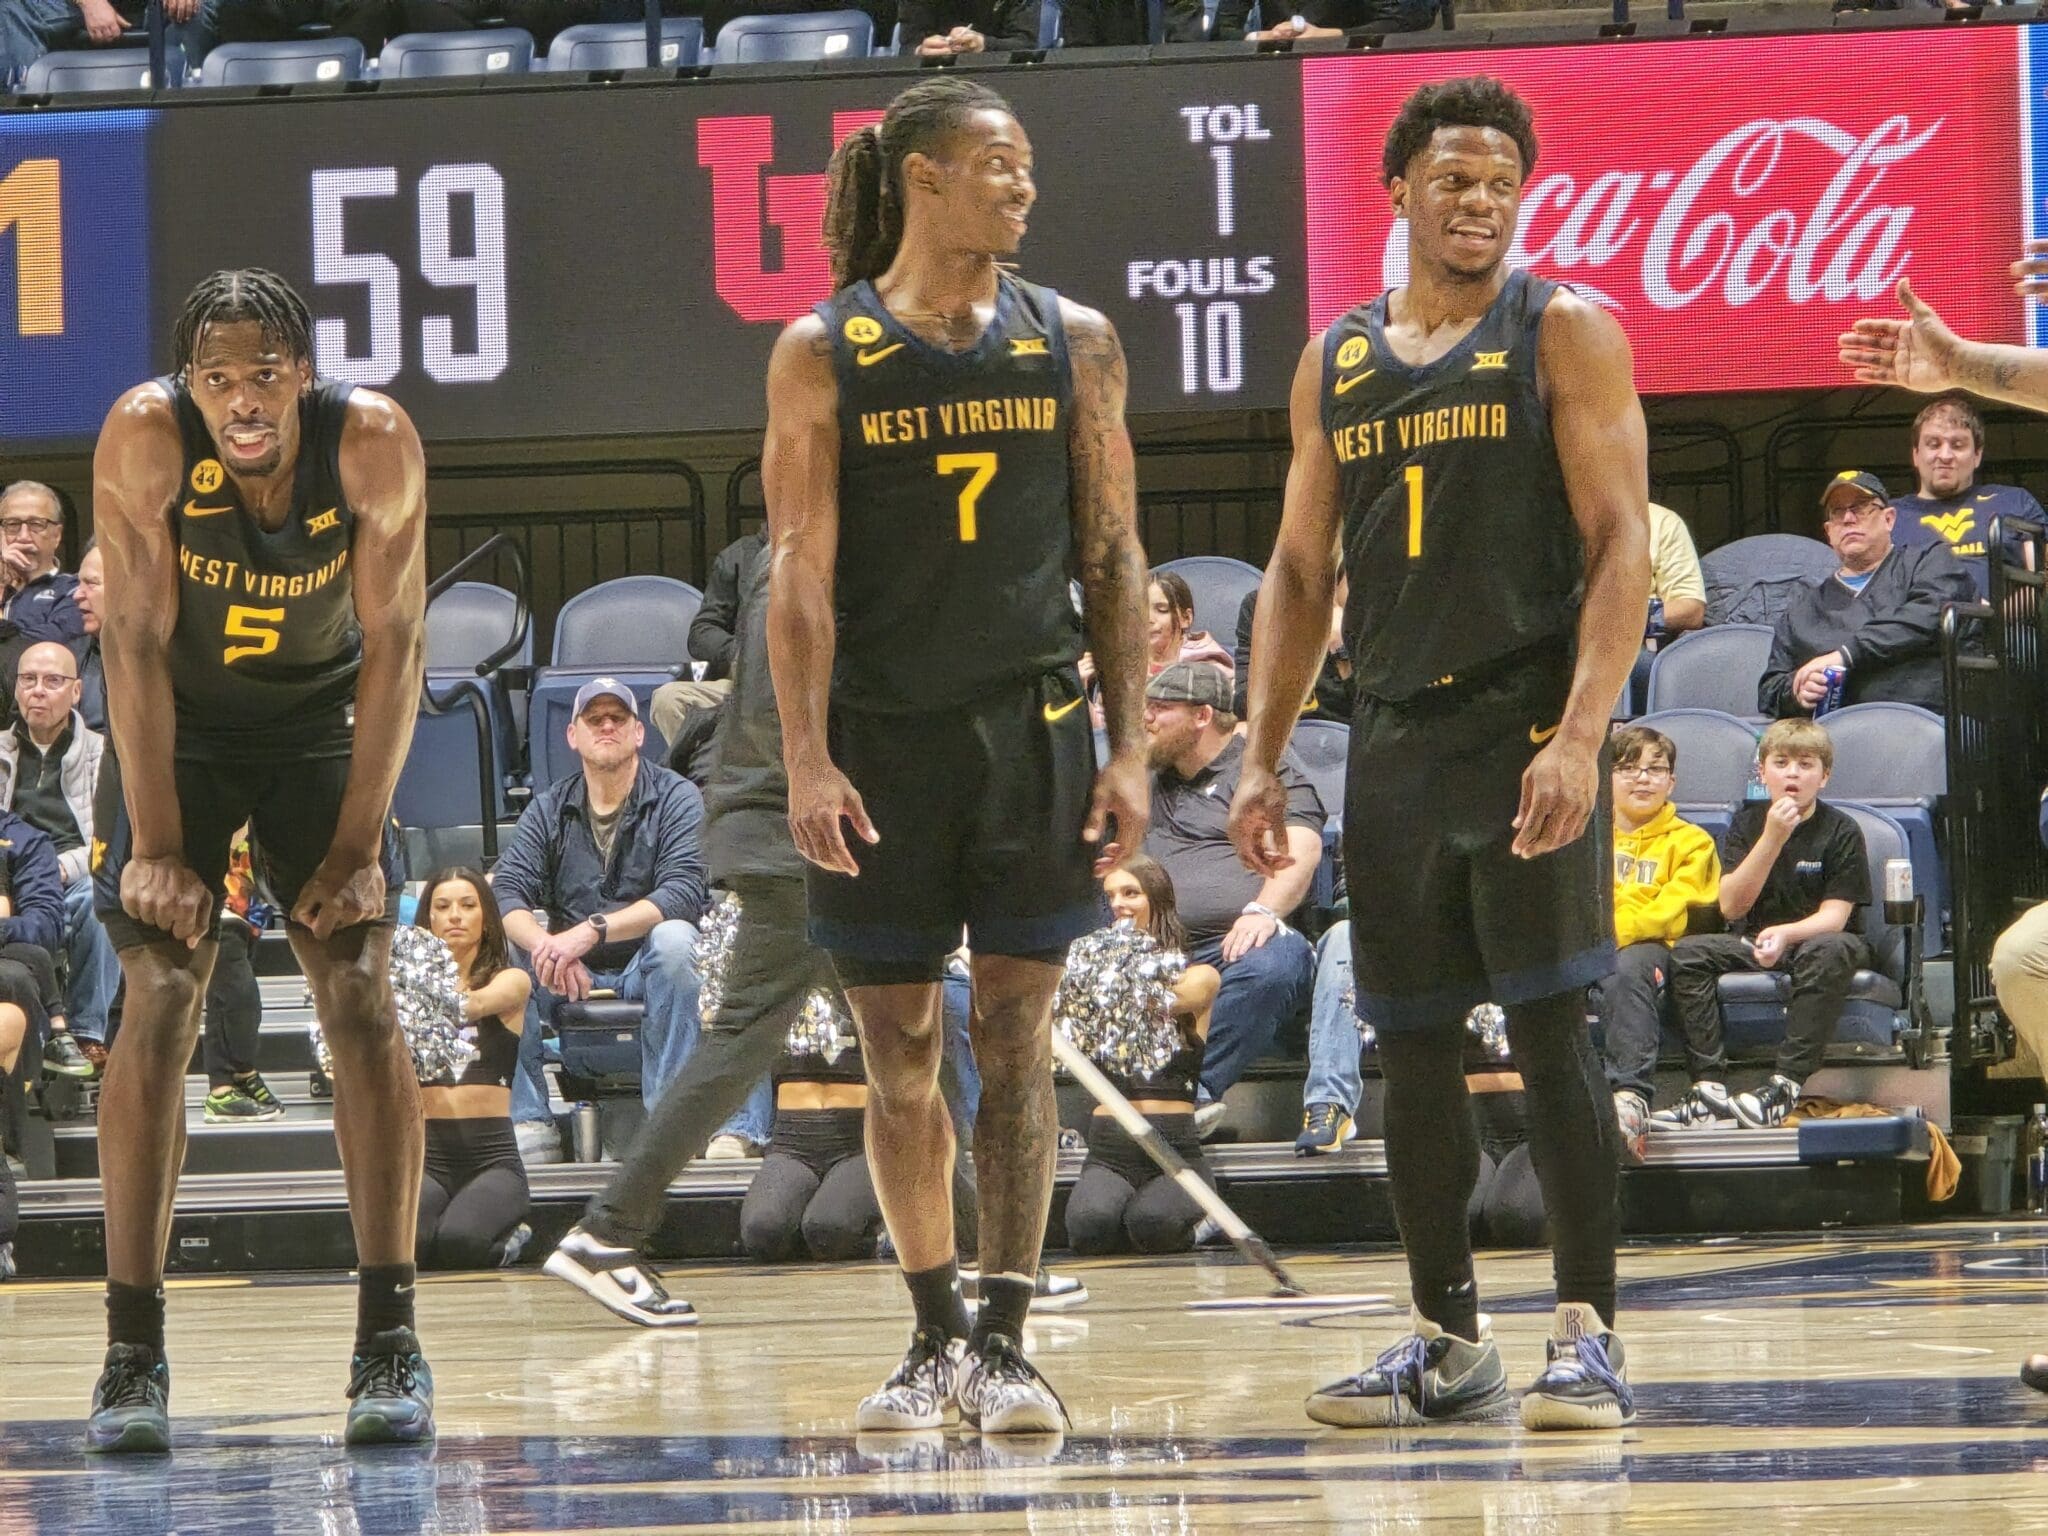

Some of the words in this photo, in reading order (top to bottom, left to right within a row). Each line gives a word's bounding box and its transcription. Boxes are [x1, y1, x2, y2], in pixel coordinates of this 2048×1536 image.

[1180, 103, 1272, 142] TOL
[1210, 146, 1234, 236] 1
[1383, 114, 1946, 310] ca-Cola
[311, 163, 509, 385] 59
[1127, 256, 1276, 298] FOULS
[1175, 301, 1243, 394] 10
[861, 407, 929, 444] WEST
[938, 397, 1057, 435] VIRGINIA
[1333, 420, 1385, 463] WEST
[1399, 404, 1506, 449] VIRGINIA
[195, 472, 216, 487] 44
[936, 452, 998, 542] 7
[1405, 465, 1424, 558] 1
[180, 544, 239, 589] WEST
[244, 550, 348, 598] VIRGINIA
[224, 605, 286, 665] 5
